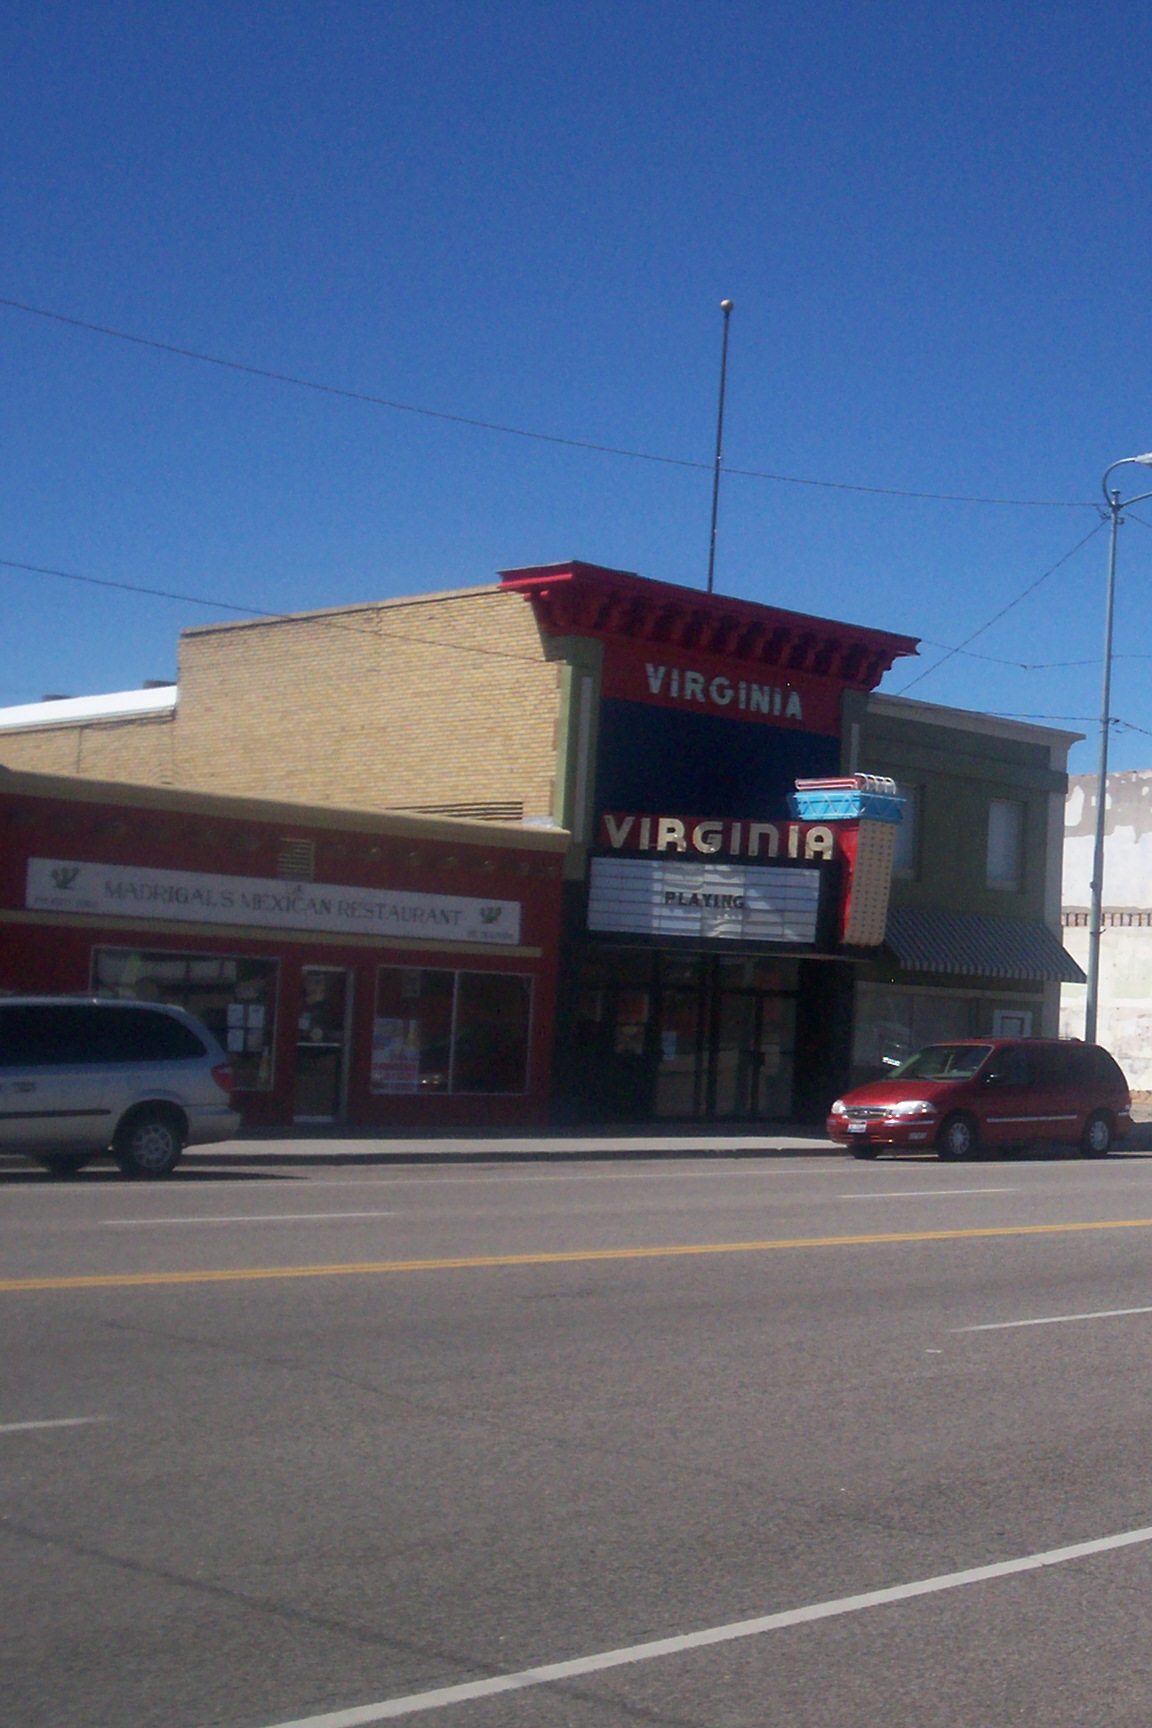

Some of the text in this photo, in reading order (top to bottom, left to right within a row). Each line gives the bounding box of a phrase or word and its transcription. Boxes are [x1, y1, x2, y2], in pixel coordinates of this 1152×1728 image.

[645, 663, 803, 720] VIRGINIA
[603, 815, 835, 861] VIRGINIA
[241, 891, 332, 916] MEXICAN
[337, 900, 463, 926] RESTAURANT
[664, 891, 744, 909] PLAYING
